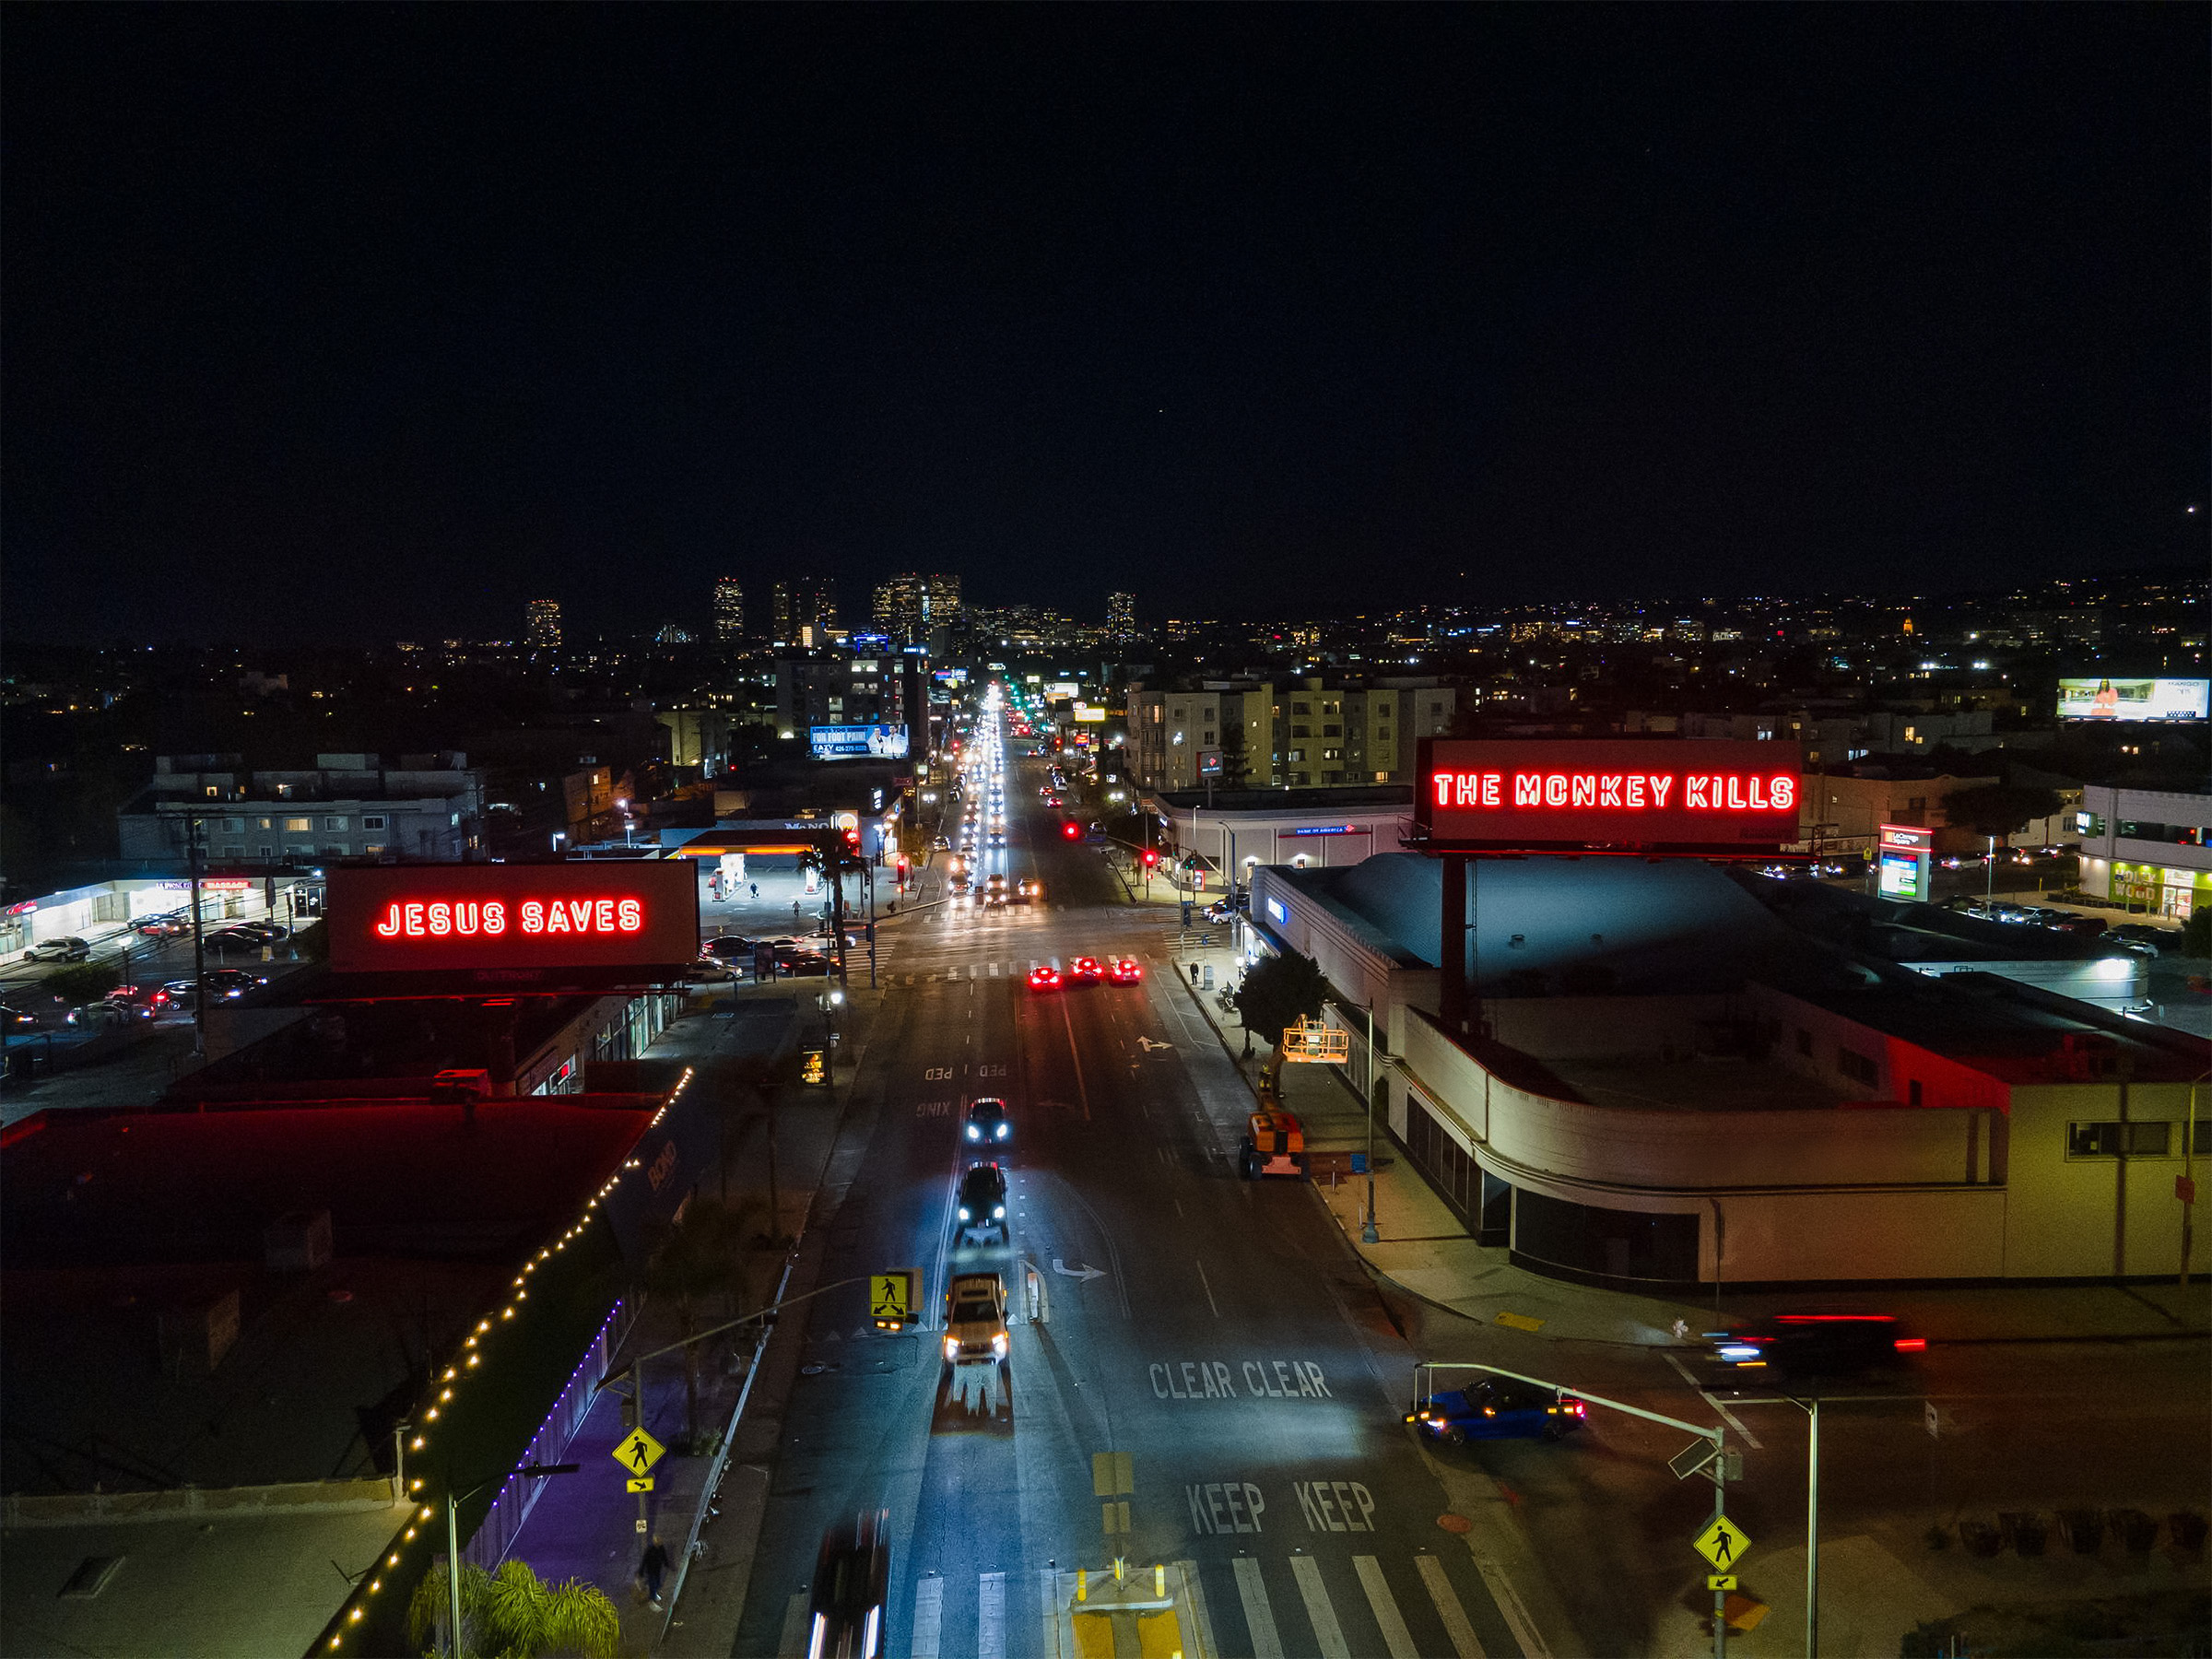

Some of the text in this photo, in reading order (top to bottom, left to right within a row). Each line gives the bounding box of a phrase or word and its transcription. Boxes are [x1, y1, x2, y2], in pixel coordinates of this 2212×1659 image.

[813, 733, 828, 743] FOR
[828, 733, 845, 742] FOOT
[1433, 774, 1794, 809] THE MONKEY KILLS
[378, 900, 641, 935] JESUS SAVES
[925, 1066, 952, 1080] PED
[979, 1065, 1006, 1077] PED
[916, 1101, 950, 1118] XING
[1149, 1360, 1333, 1399] CLEAR CLEAR
[1185, 1481, 1375, 1535] KEEP KEEP
